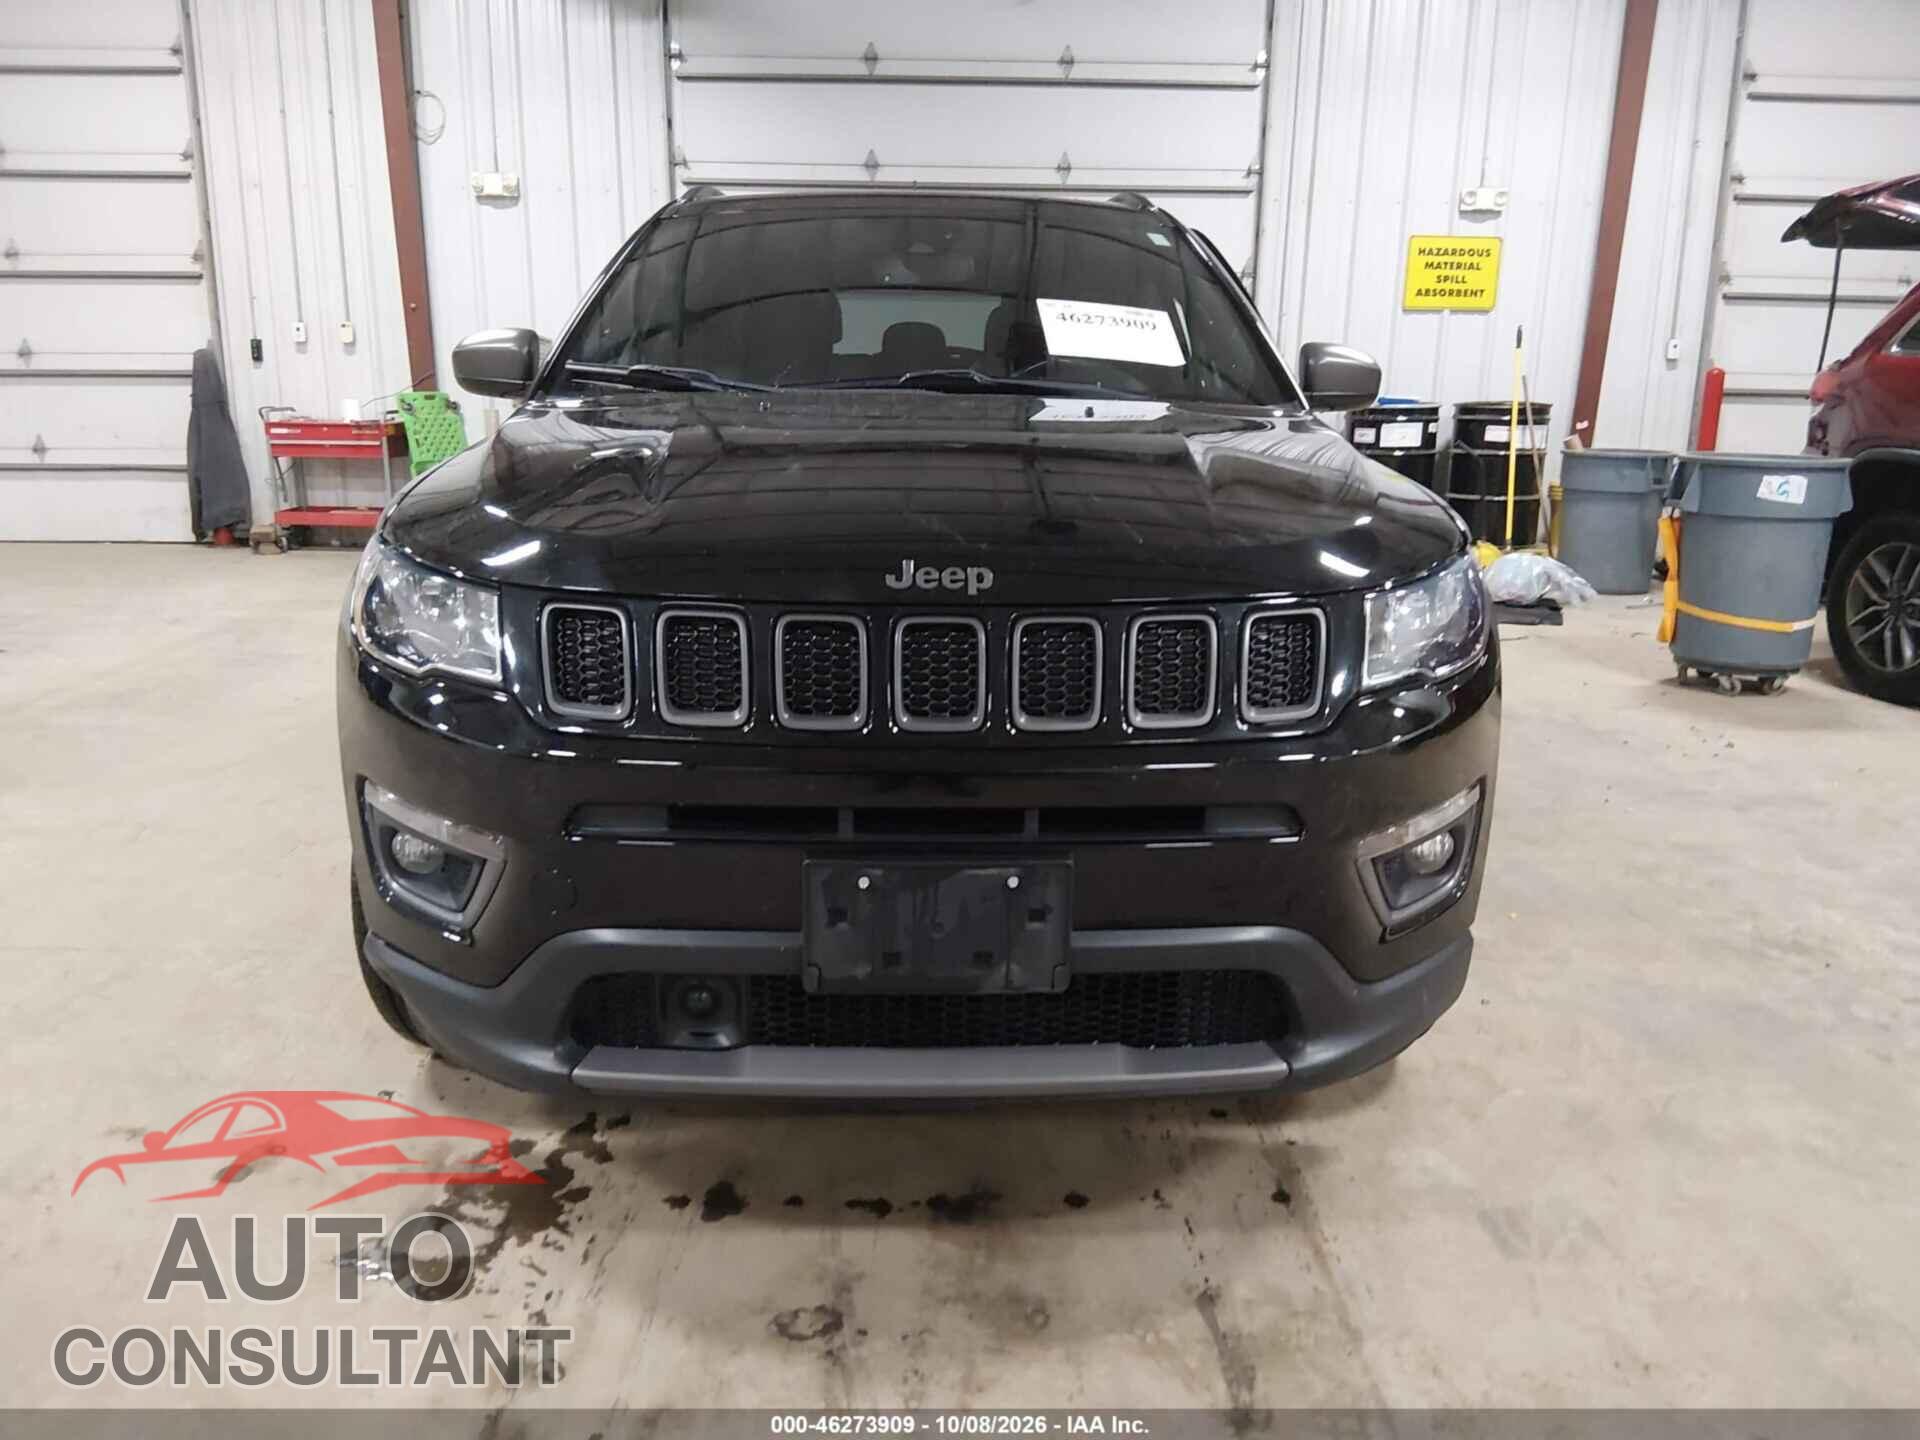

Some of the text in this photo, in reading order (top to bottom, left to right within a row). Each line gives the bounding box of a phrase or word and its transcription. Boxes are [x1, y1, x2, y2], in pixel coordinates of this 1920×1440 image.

[1417, 247, 1492, 258] HAZARDOUS
[1423, 261, 1483, 272] MATERIAL
[1435, 274, 1468, 285] SPILL
[1415, 287, 1486, 298] ABSORBENT
[1055, 311, 1157, 331] 46273909
[884, 559, 994, 596] Jeep
